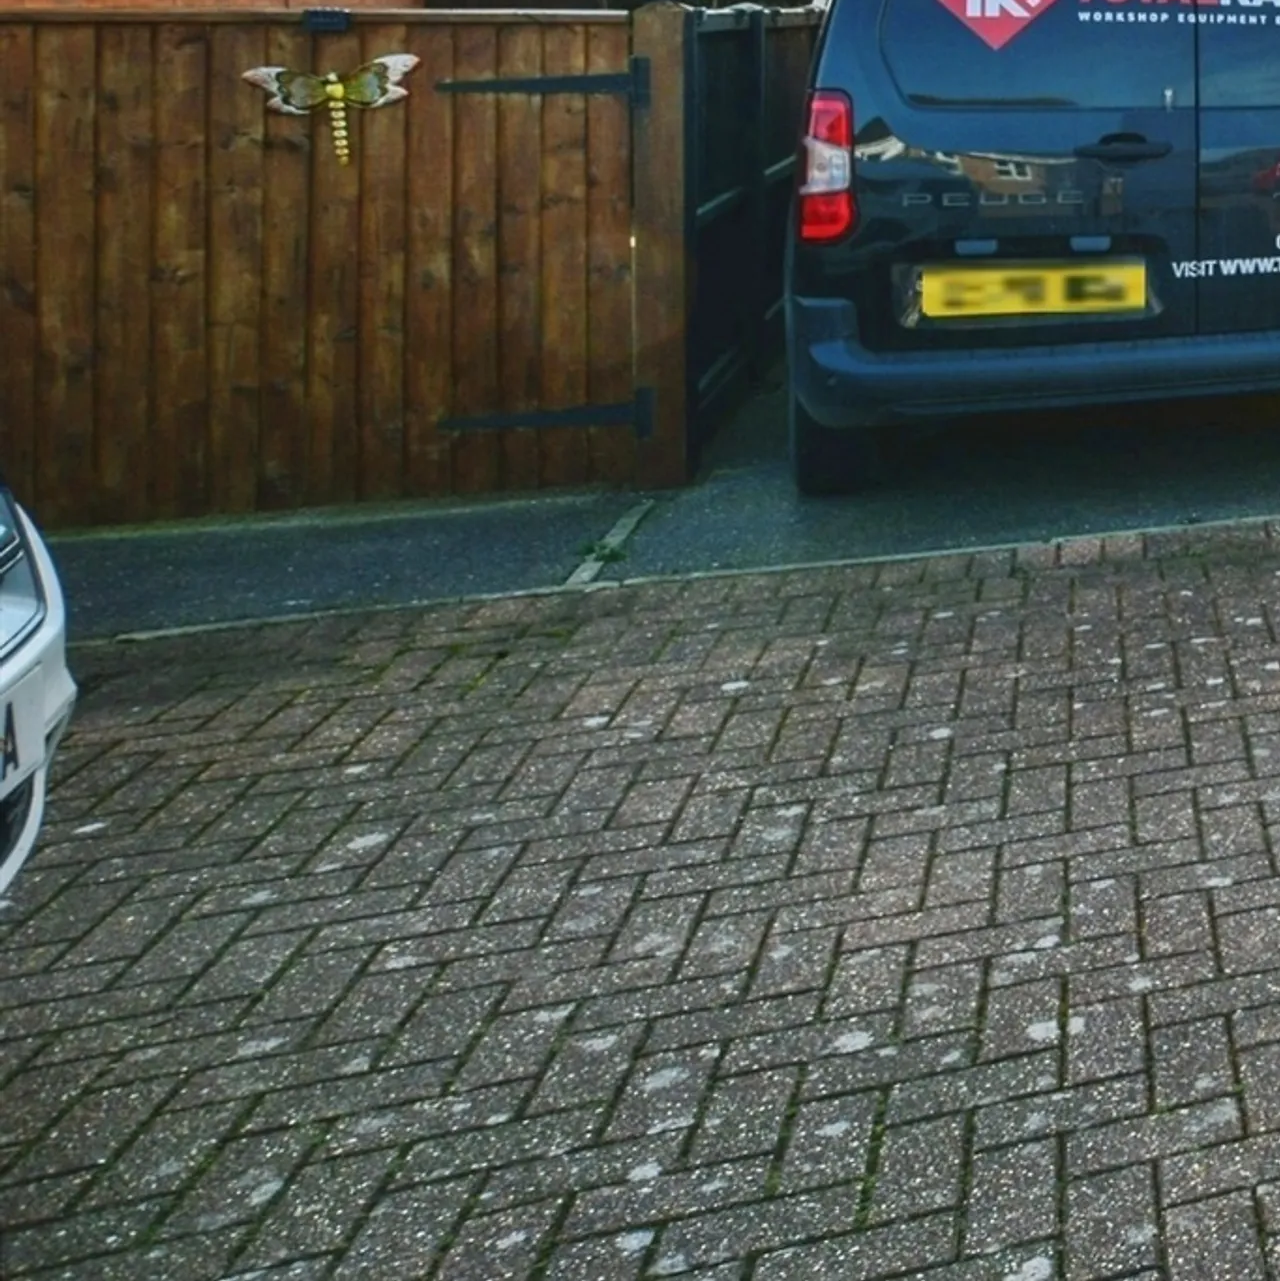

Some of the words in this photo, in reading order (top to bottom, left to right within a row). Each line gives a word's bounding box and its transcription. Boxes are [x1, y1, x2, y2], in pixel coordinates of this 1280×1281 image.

[1077, 11, 1170, 23] WORKSHOP
[1177, 12, 1268, 25] EQUIPMENT
[1171, 259, 1216, 279] VISIT
